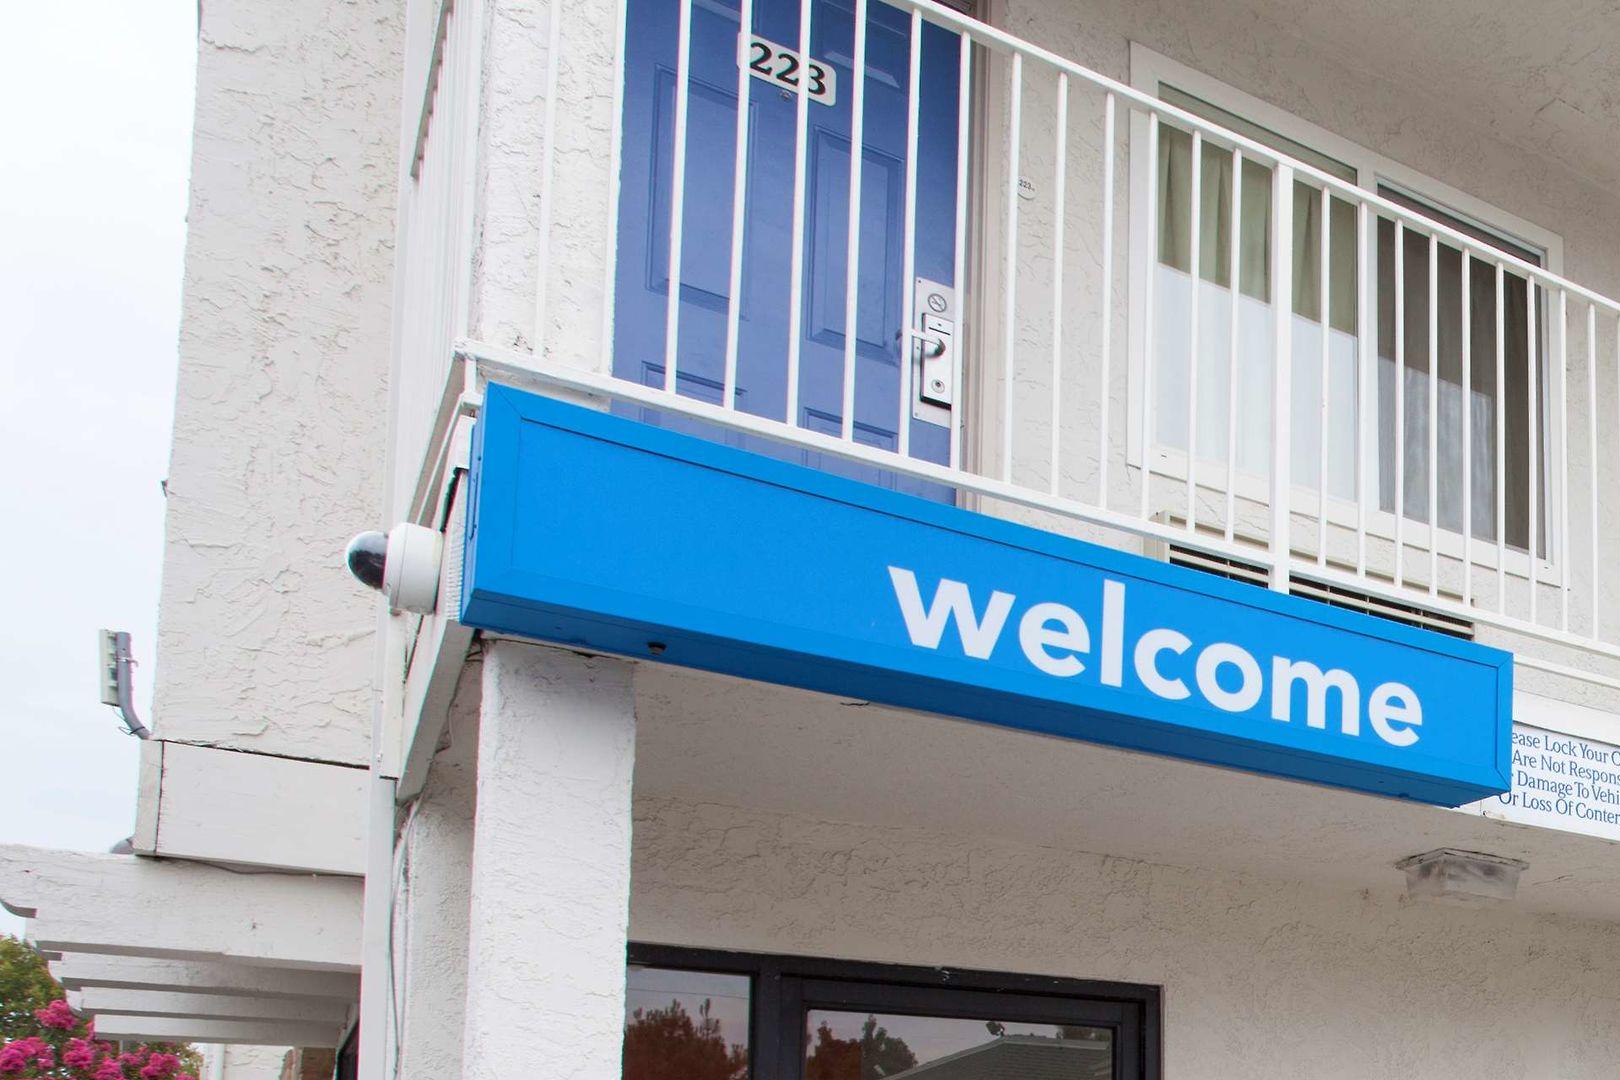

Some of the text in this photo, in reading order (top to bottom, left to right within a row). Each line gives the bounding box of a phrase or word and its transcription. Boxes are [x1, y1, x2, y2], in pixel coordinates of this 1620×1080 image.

[750, 42, 826, 95] 223
[887, 566, 1423, 747] welcome
[1512, 749, 1537, 768] Are
[1541, 754, 1566, 774] Not
[1545, 735, 1577, 757] Lock
[1579, 743, 1608, 763] Your
[1517, 770, 1573, 799] Damage
[1574, 781, 1590, 799] To
[1499, 791, 1518, 806] Or
[1522, 792, 1552, 812] Loss
[1556, 799, 1574, 816] Of
